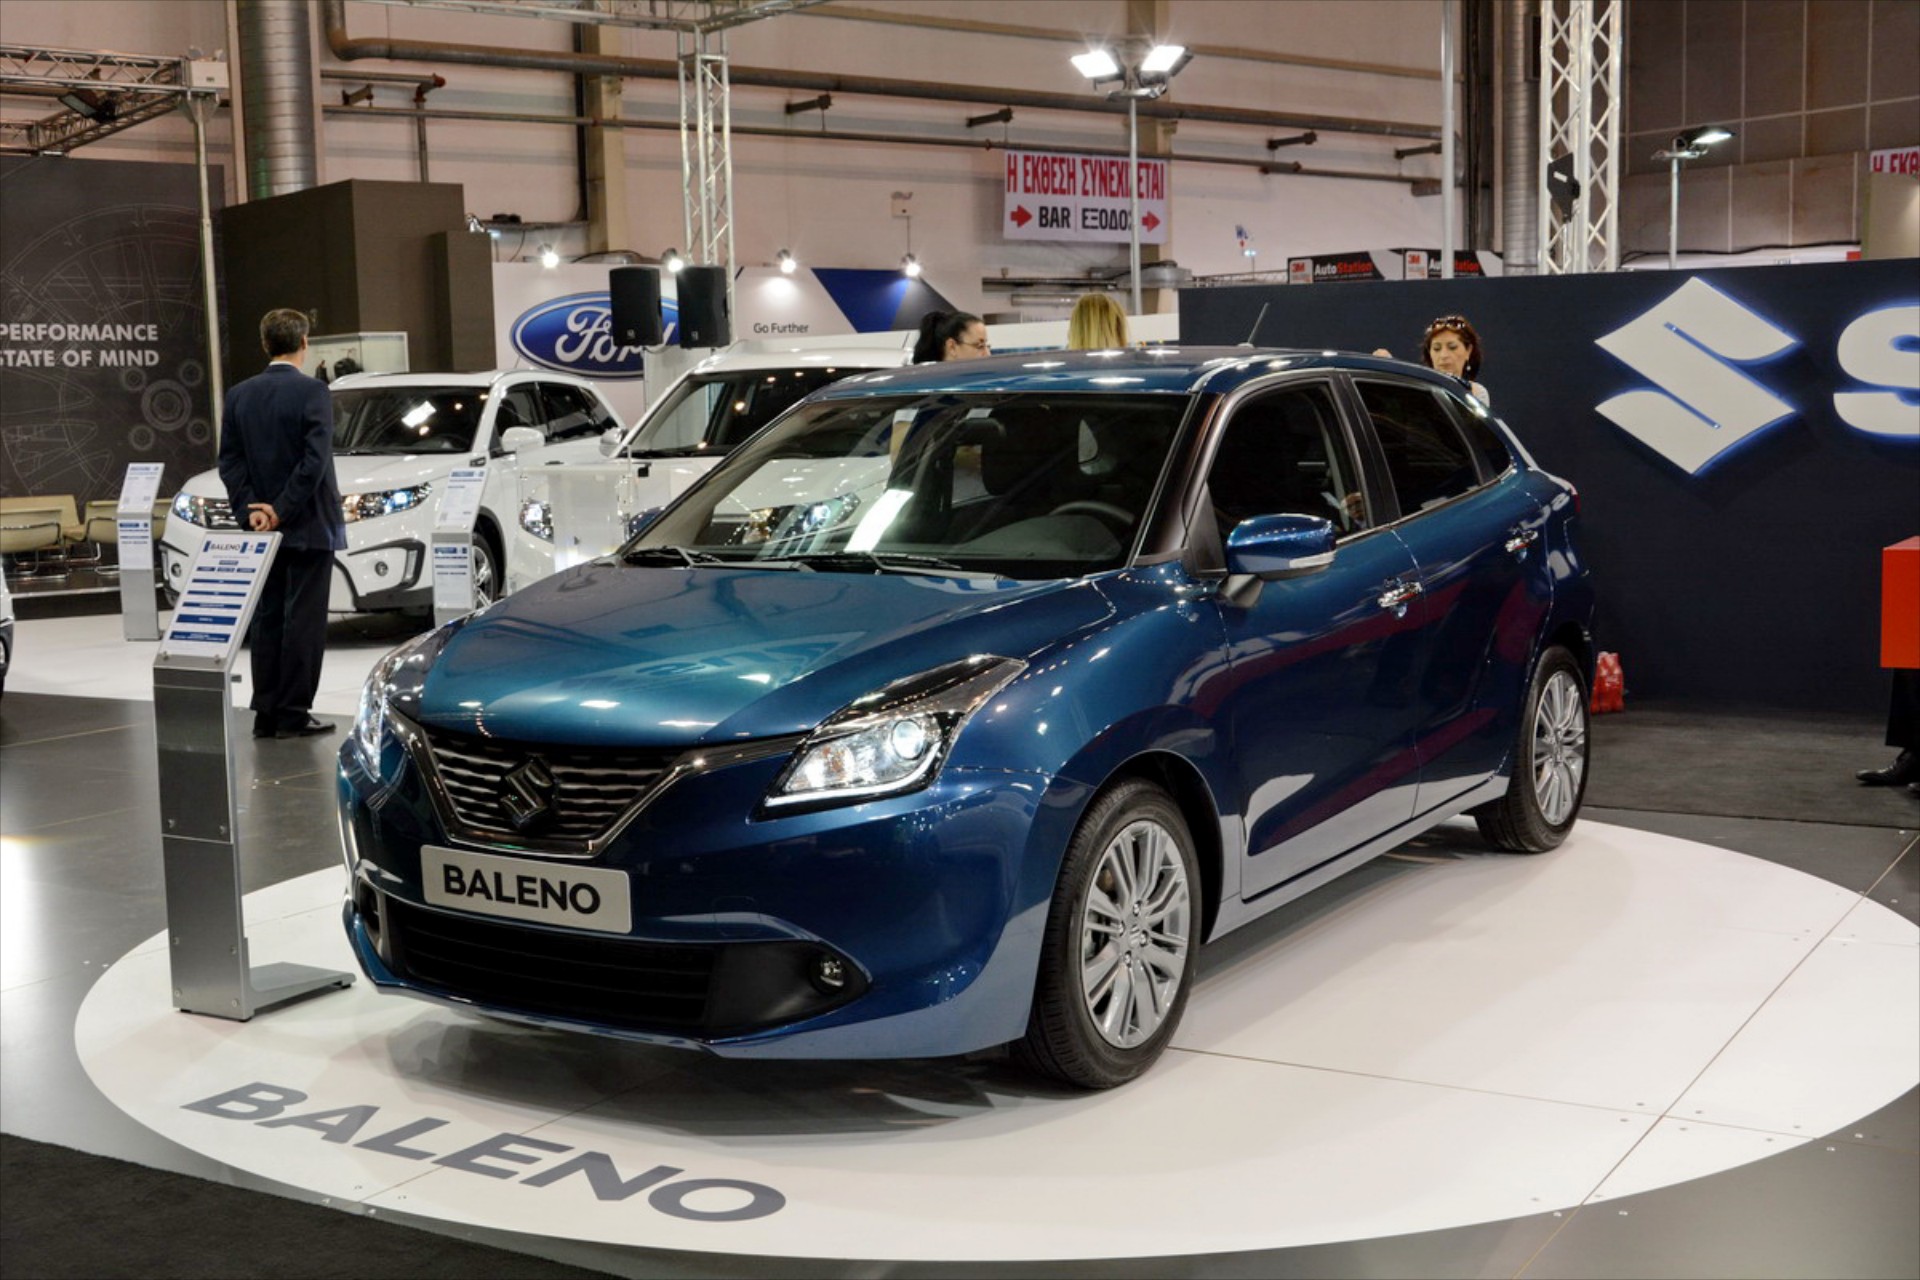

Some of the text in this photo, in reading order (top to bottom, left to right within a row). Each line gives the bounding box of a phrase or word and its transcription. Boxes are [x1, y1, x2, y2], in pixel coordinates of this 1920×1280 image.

[1007, 154, 1164, 200] Η ΕΚΘΕΣΗ ΣΥΝΕΧΙΕΤΑΙ
[1039, 206, 1071, 228] BAR
[0, 323, 159, 341] PERFORMANCE
[753, 321, 809, 334] Go Further
[62, 350, 92, 367] OF
[99, 350, 160, 367] MIND
[210, 543, 241, 551] BALENO
[443, 863, 601, 915] BALENO
[180, 1081, 787, 1223] BALENO
